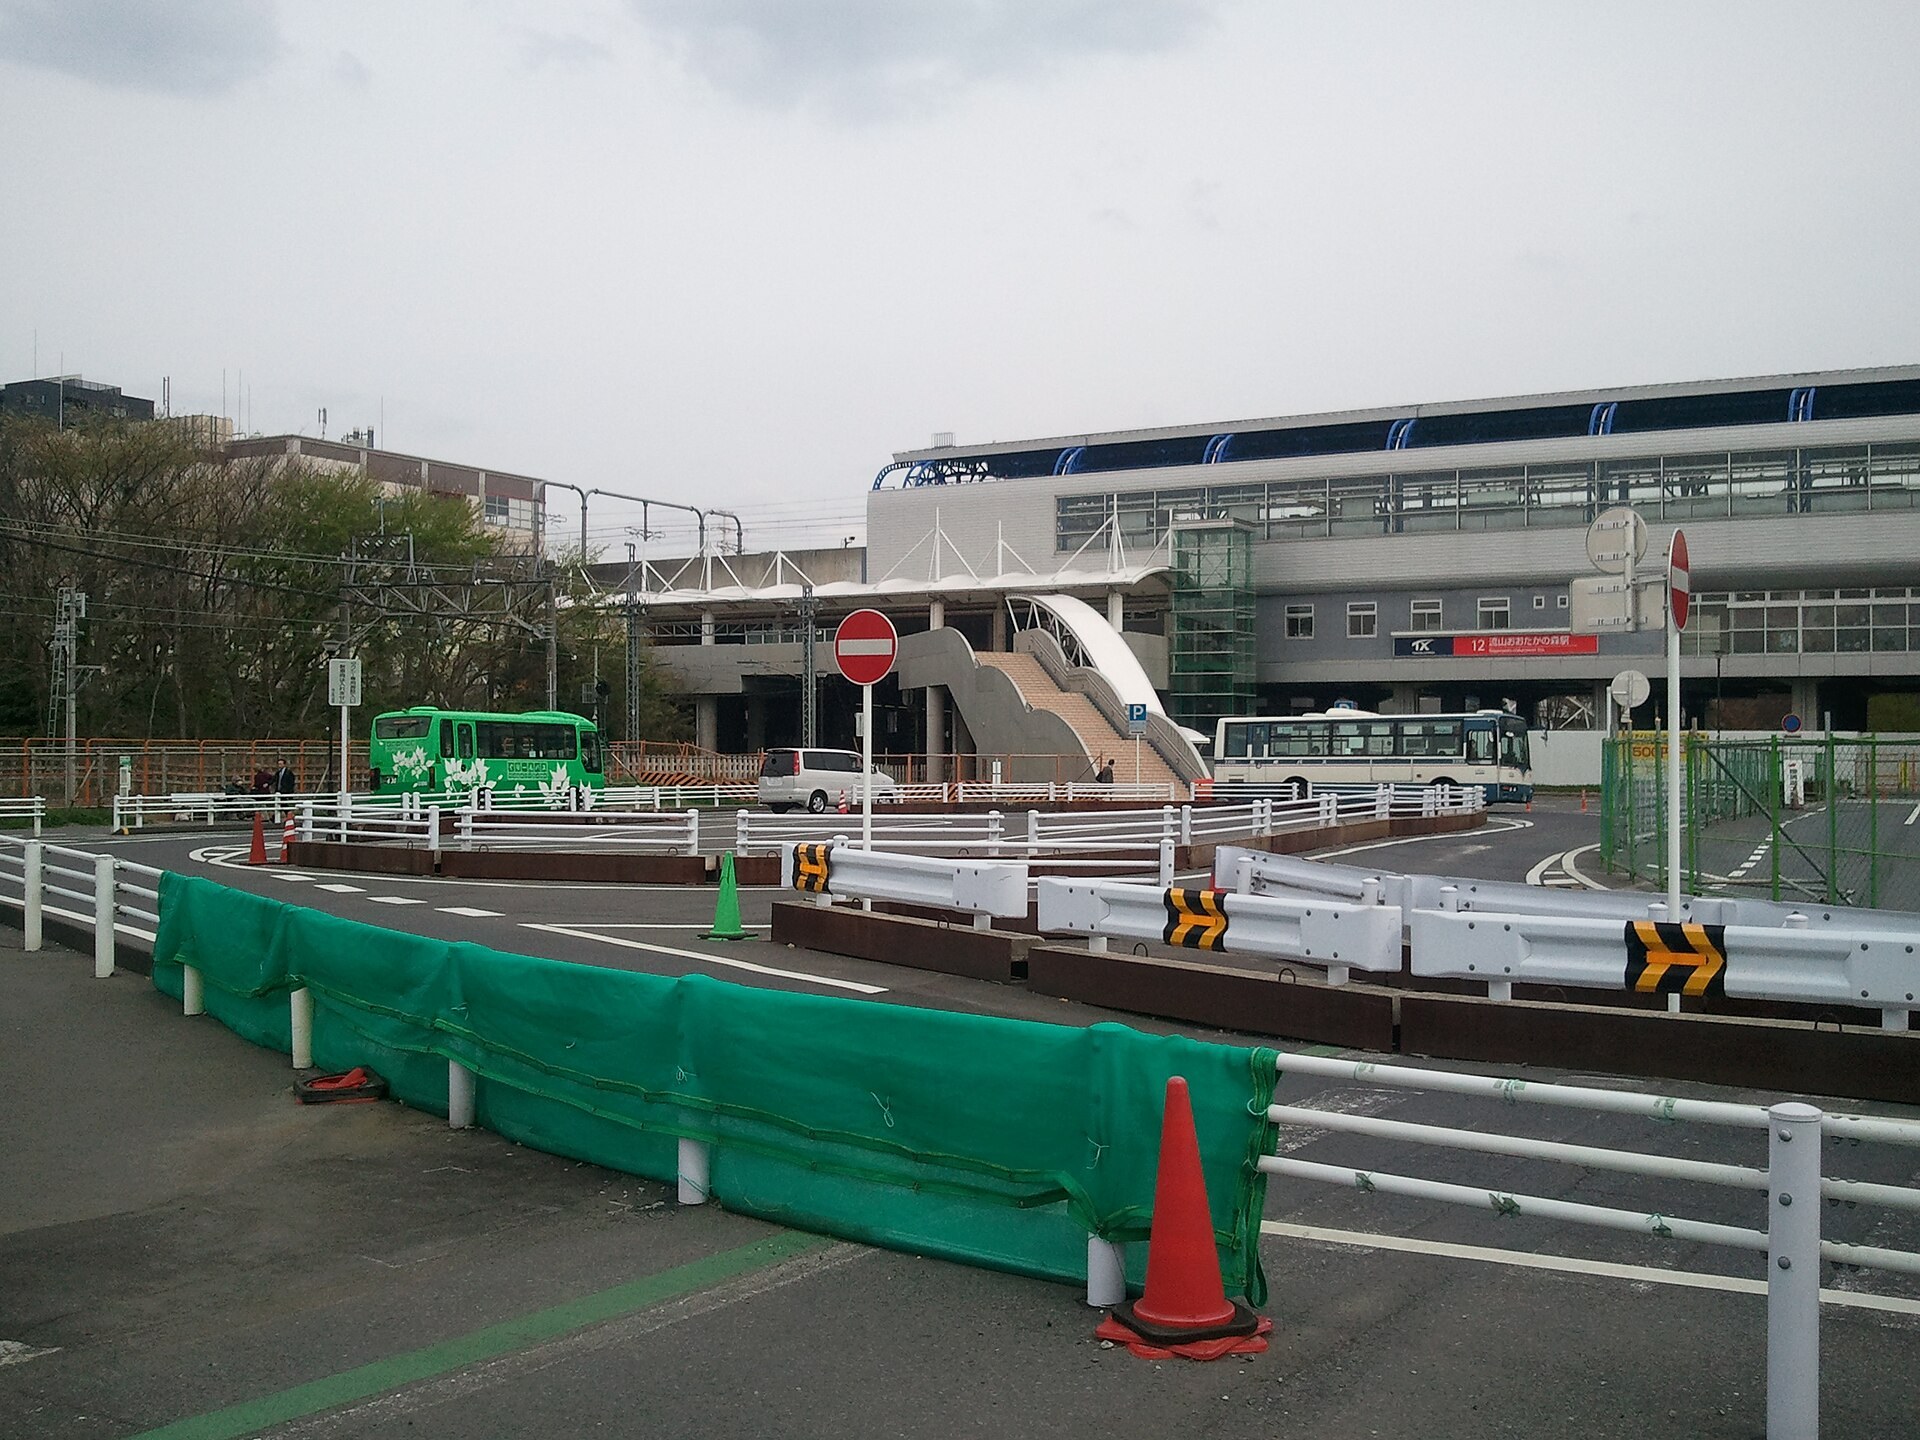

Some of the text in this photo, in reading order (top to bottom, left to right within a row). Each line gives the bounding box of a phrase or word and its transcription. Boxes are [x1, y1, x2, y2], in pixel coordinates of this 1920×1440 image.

[1471, 635, 1570, 652] 12 流山おおたかの森駅
[1133, 705, 1145, 720] P
